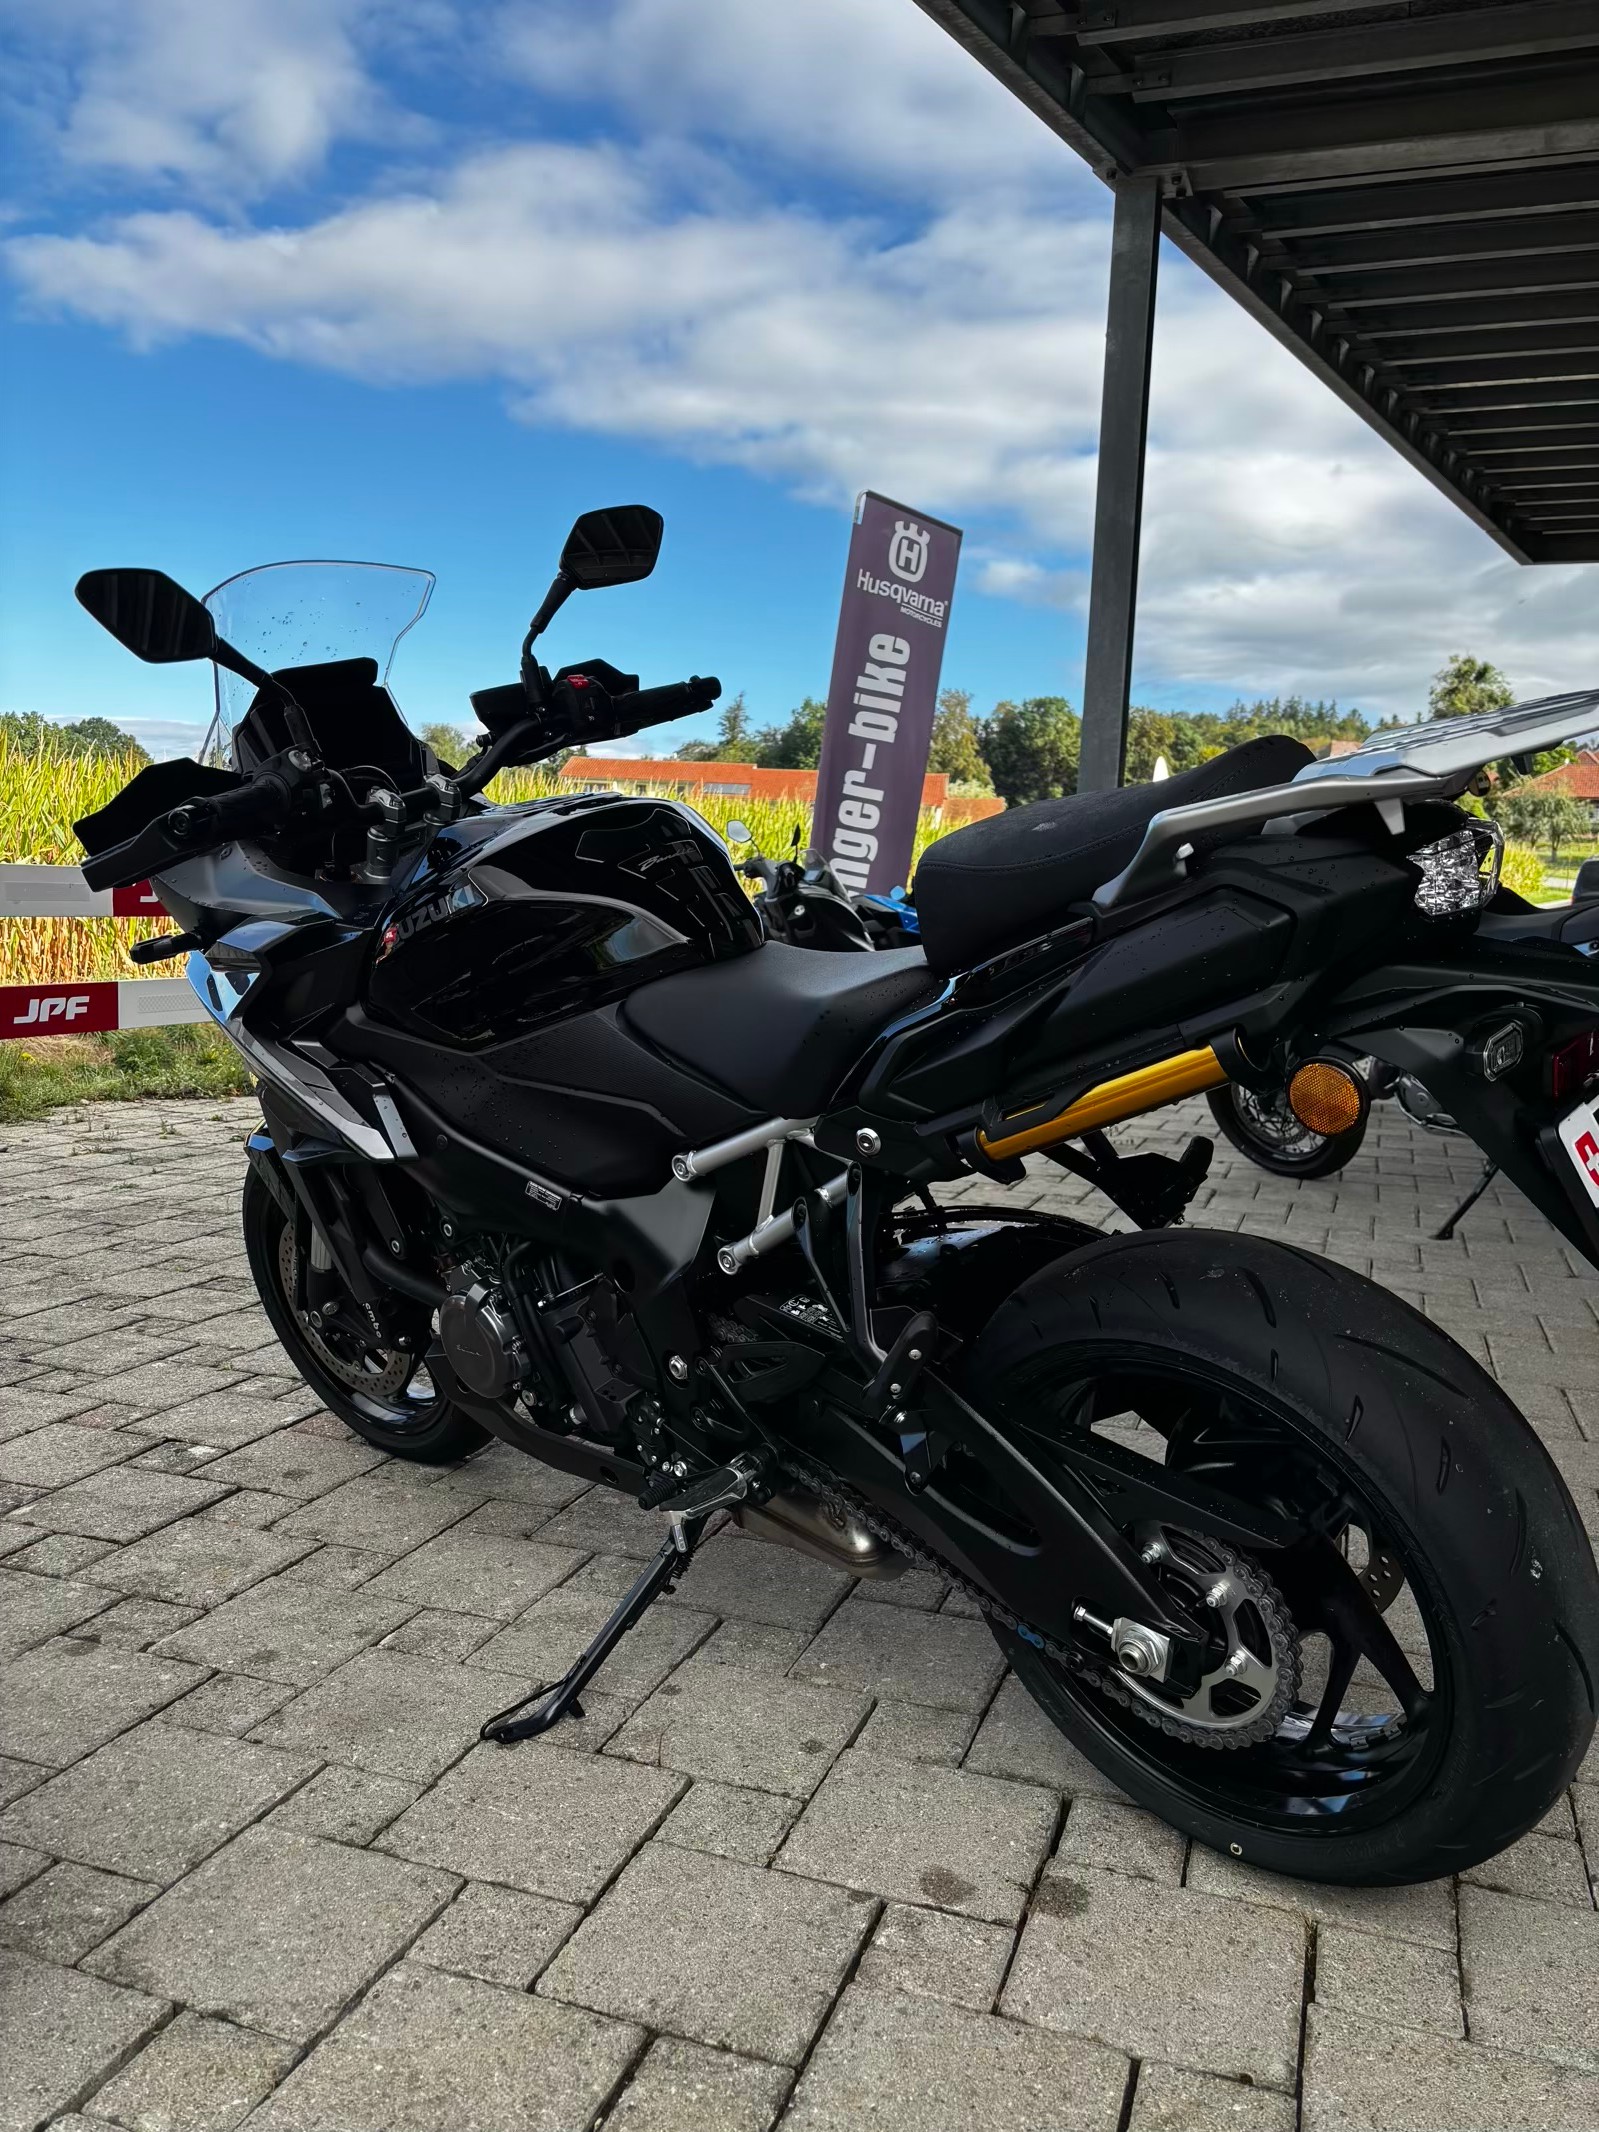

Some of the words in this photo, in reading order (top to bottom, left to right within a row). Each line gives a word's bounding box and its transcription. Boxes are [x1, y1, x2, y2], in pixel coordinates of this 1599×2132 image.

[857, 569, 945, 617] Husqvarna
[900, 606, 943, 628] MOTORCYCLES
[829, 633, 911, 896] nger-bike
[13, 995, 90, 1024] JPF
